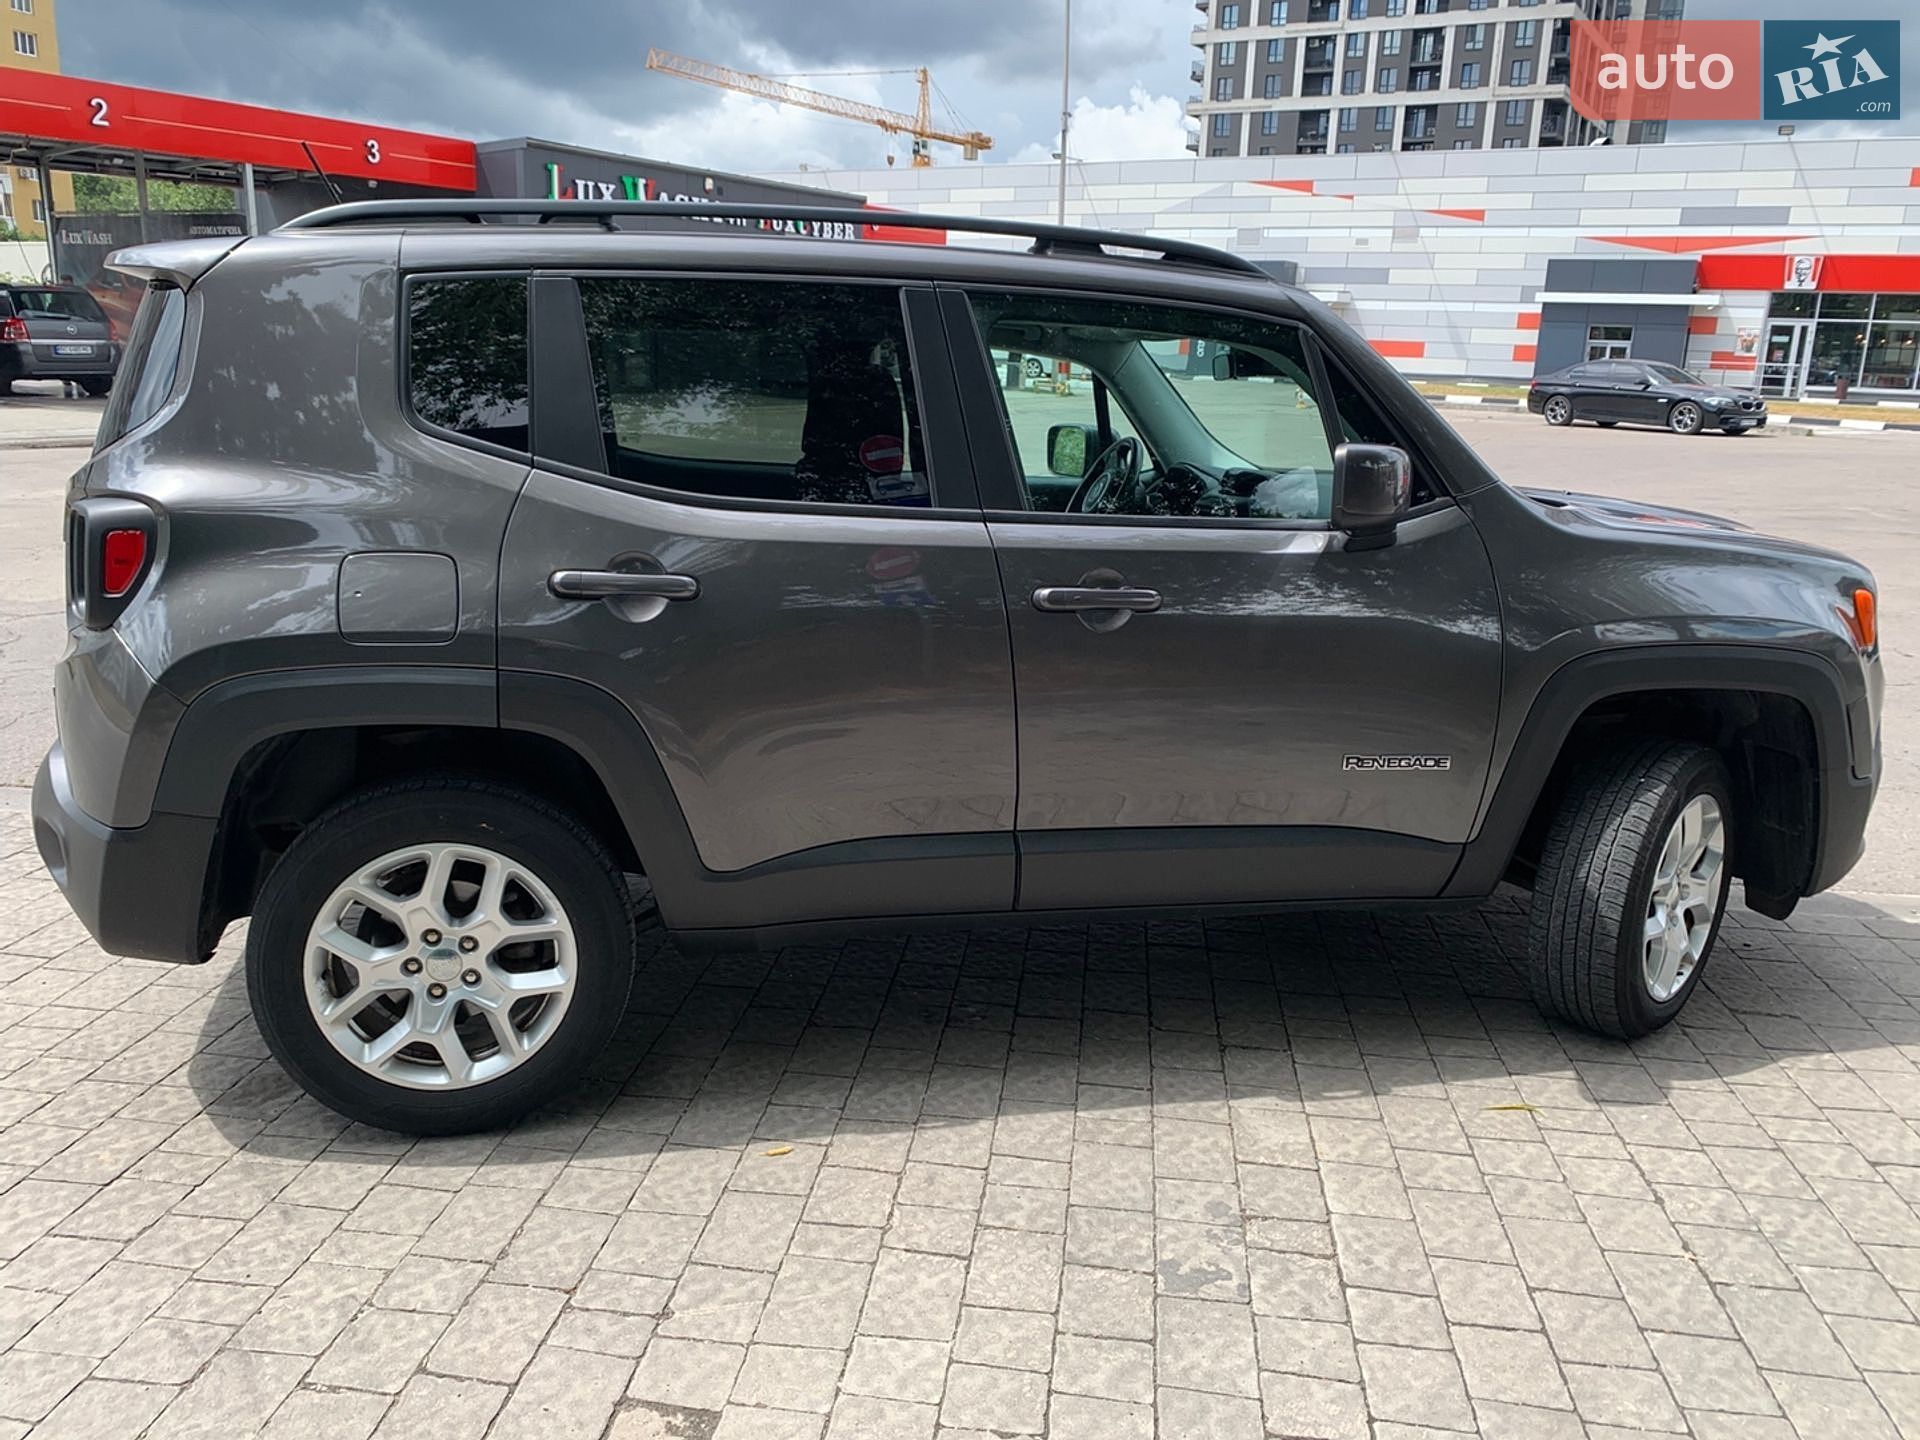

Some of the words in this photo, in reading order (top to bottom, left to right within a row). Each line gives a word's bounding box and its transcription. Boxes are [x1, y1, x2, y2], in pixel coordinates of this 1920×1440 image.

[90, 97, 110, 127] 2
[366, 138, 380, 164] 3
[1342, 754, 1451, 771] RENEGADE
